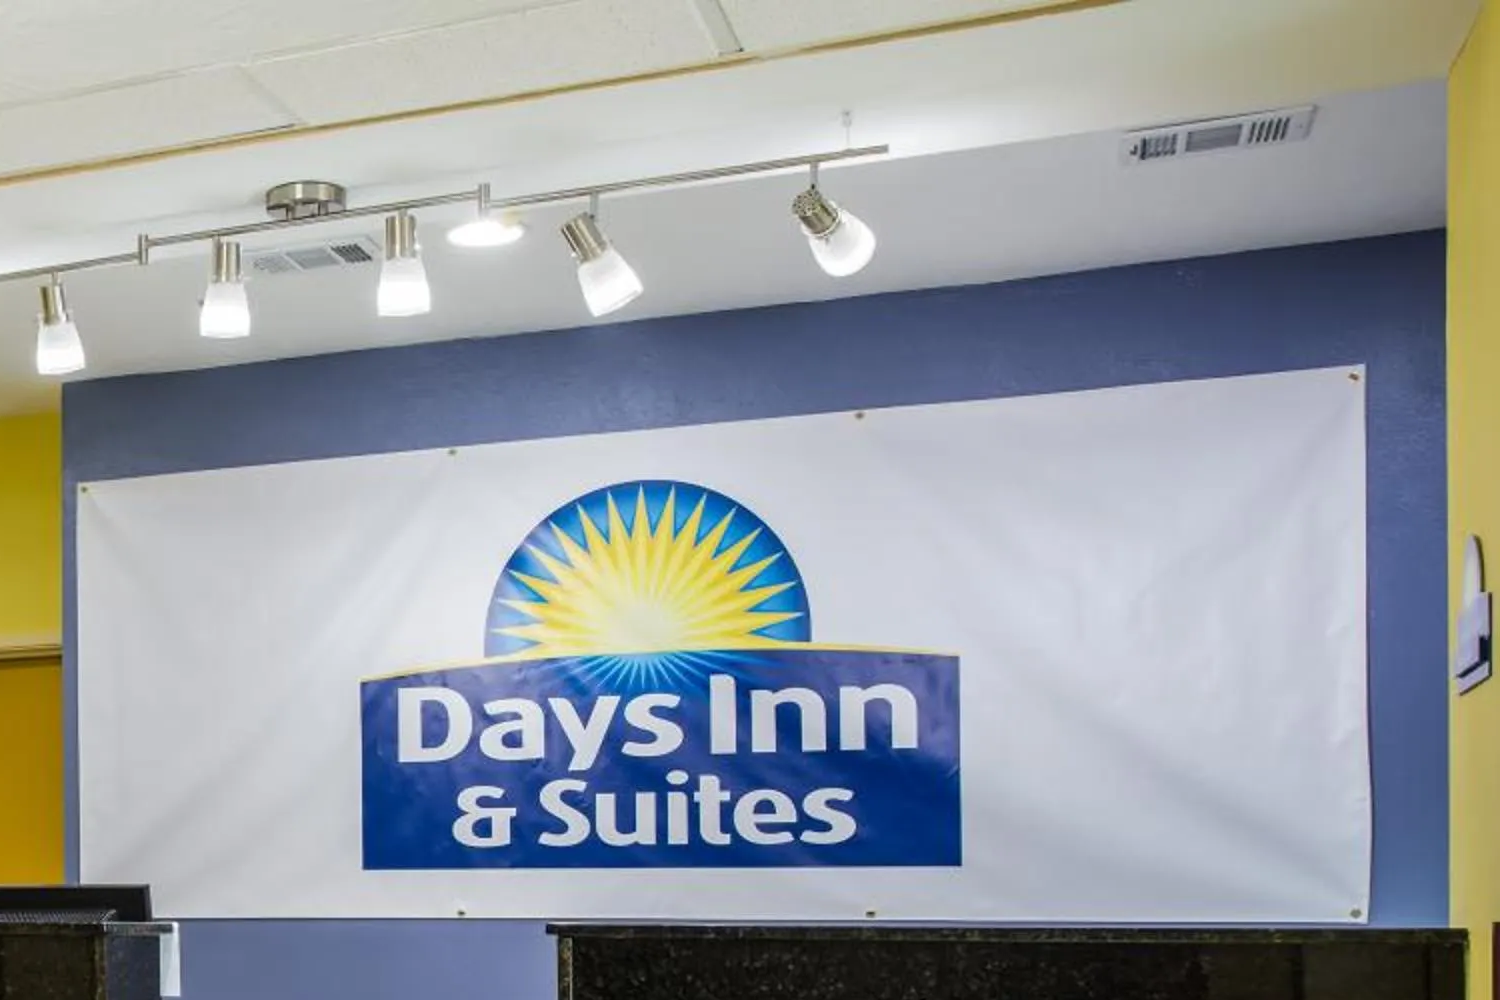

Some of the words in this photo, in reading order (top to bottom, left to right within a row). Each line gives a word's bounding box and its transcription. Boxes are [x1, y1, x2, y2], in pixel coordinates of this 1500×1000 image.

[396, 687, 684, 771] Days
[709, 674, 918, 755] Inn
[451, 785, 517, 847] &
[537, 770, 858, 846] Suites
